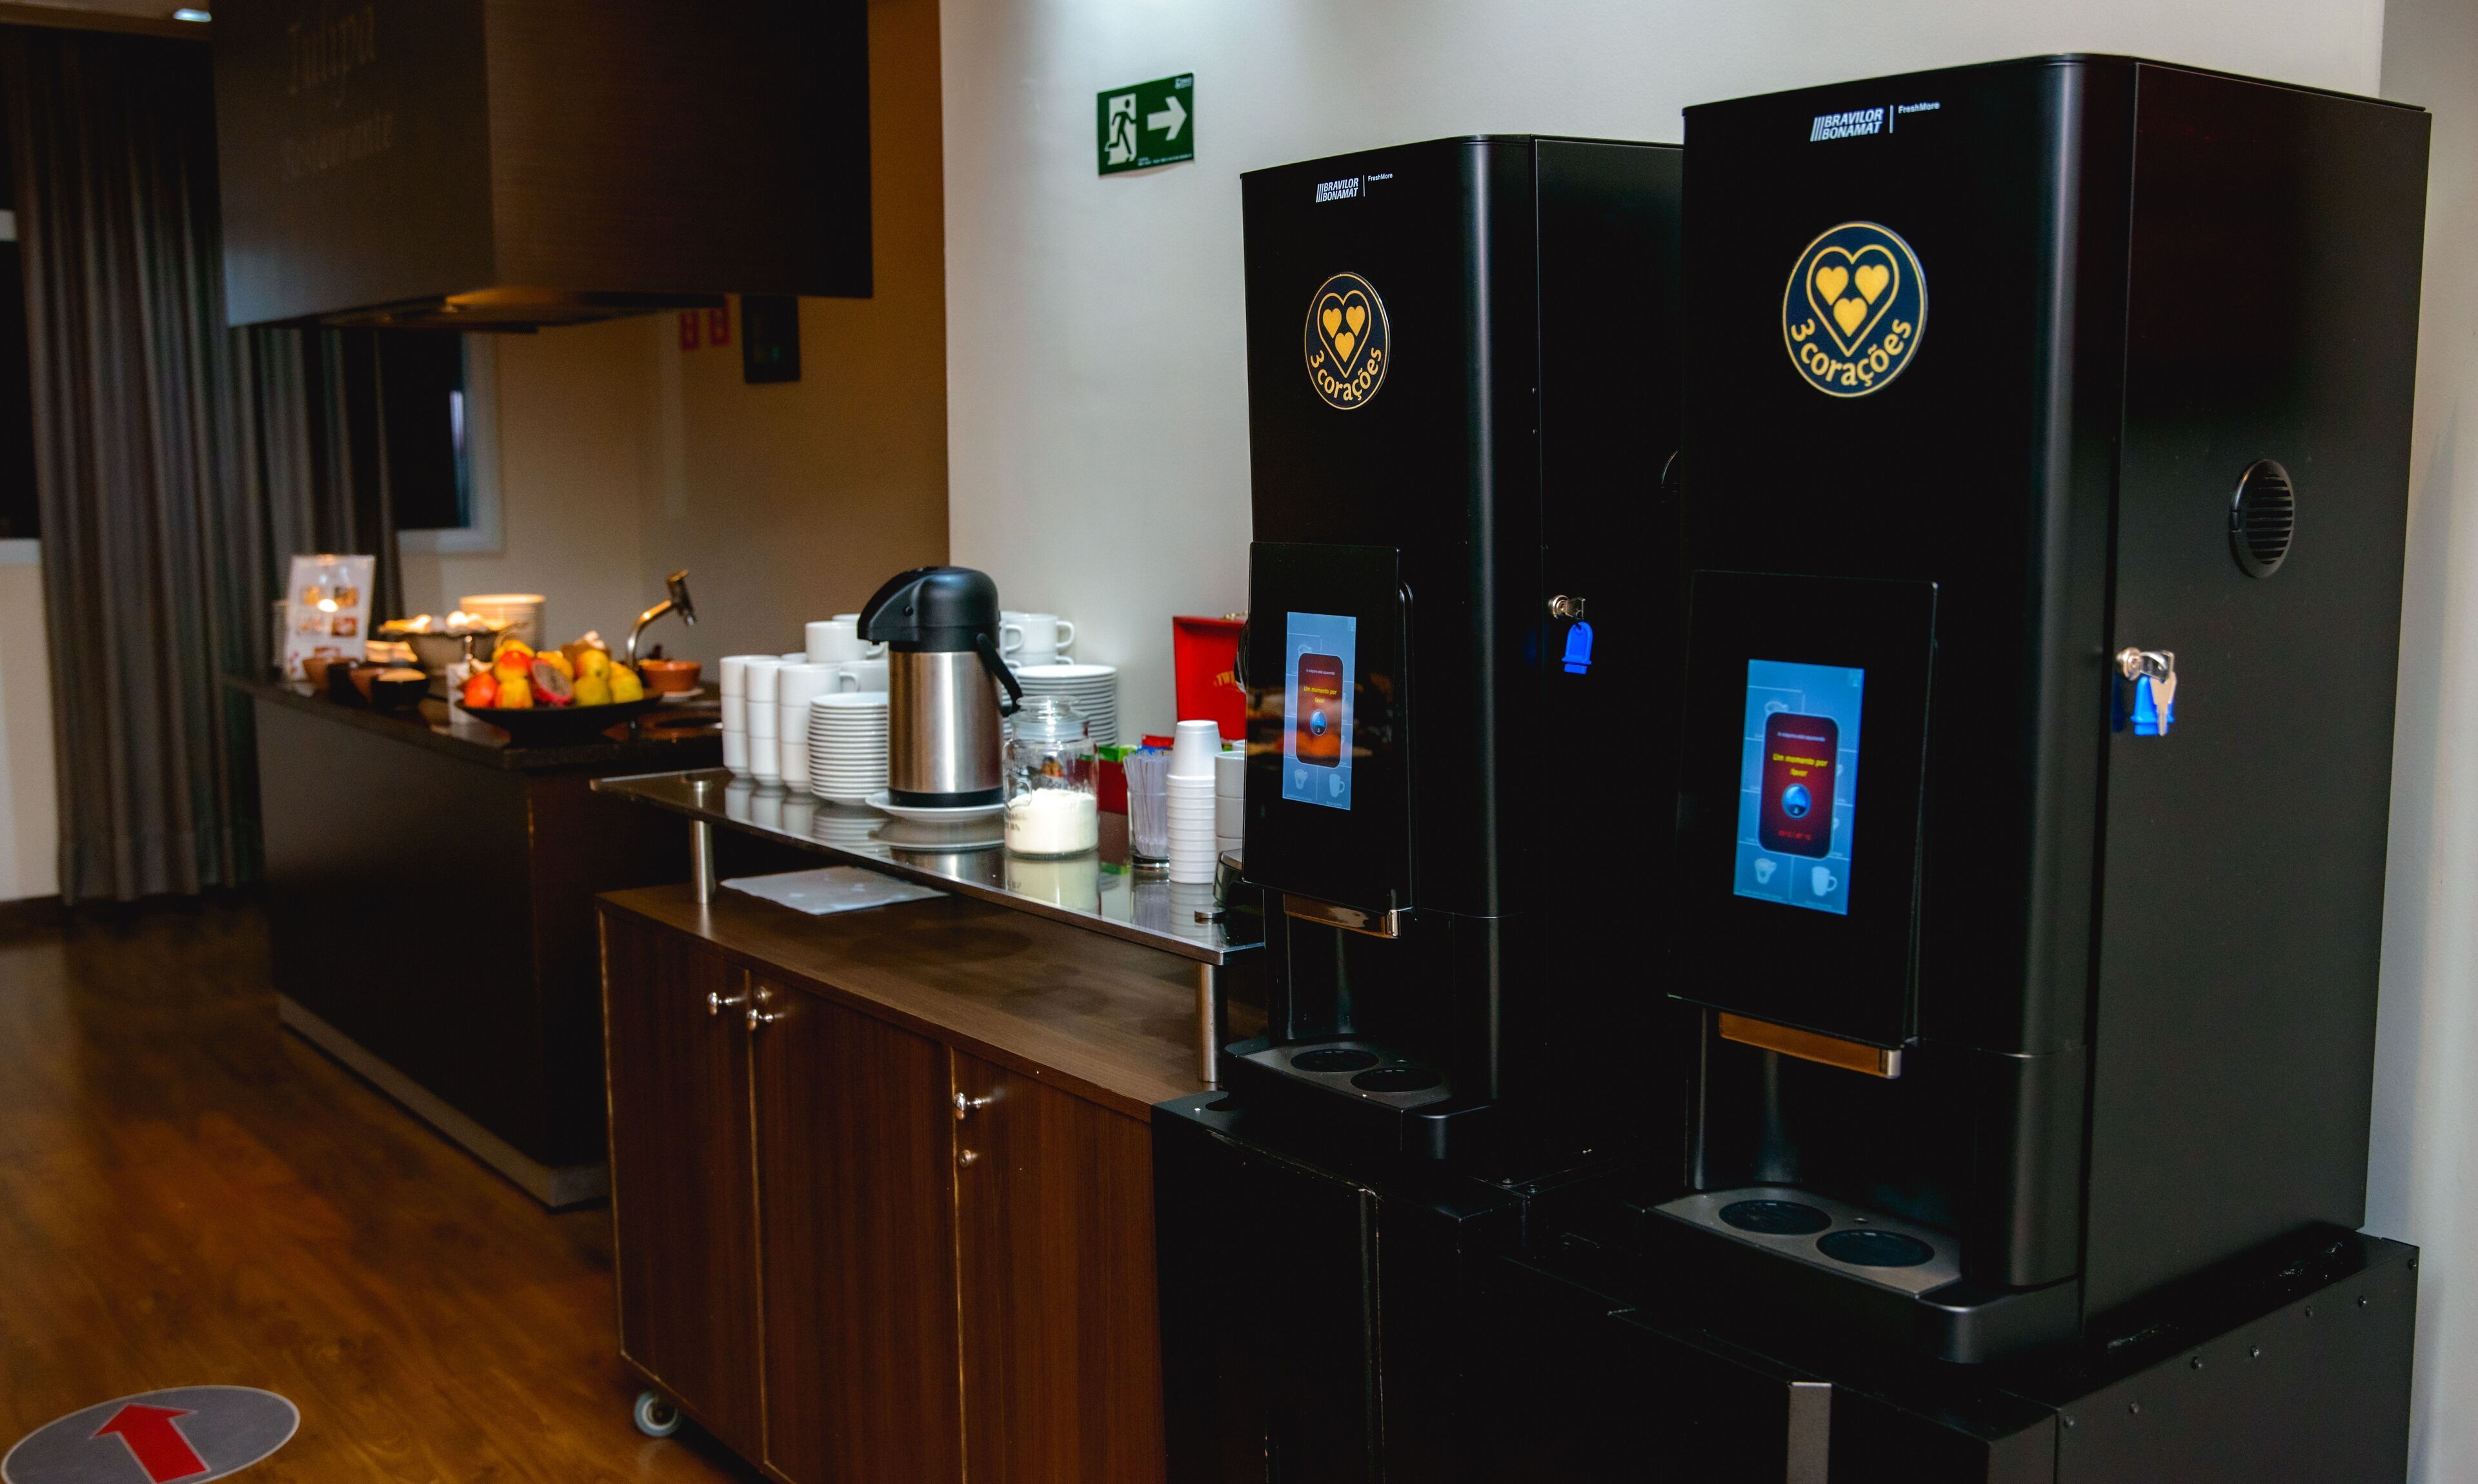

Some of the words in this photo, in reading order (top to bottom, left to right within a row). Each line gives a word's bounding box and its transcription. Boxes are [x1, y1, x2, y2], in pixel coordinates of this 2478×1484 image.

[1898, 101, 1940, 114] FreshMore
[1824, 108, 1884, 128] BRAVILOR
[1821, 121, 1883, 141] BONAMAT
[1323, 177, 1360, 192] BRAVILOR
[1367, 172, 1393, 182] FreshMore
[1322, 187, 1358, 202] BONAMAT
[1791, 317, 1816, 342] 3
[1310, 349, 1325, 369] 3
[1800, 319, 1912, 387] corações
[1317, 347, 1382, 401] corações
